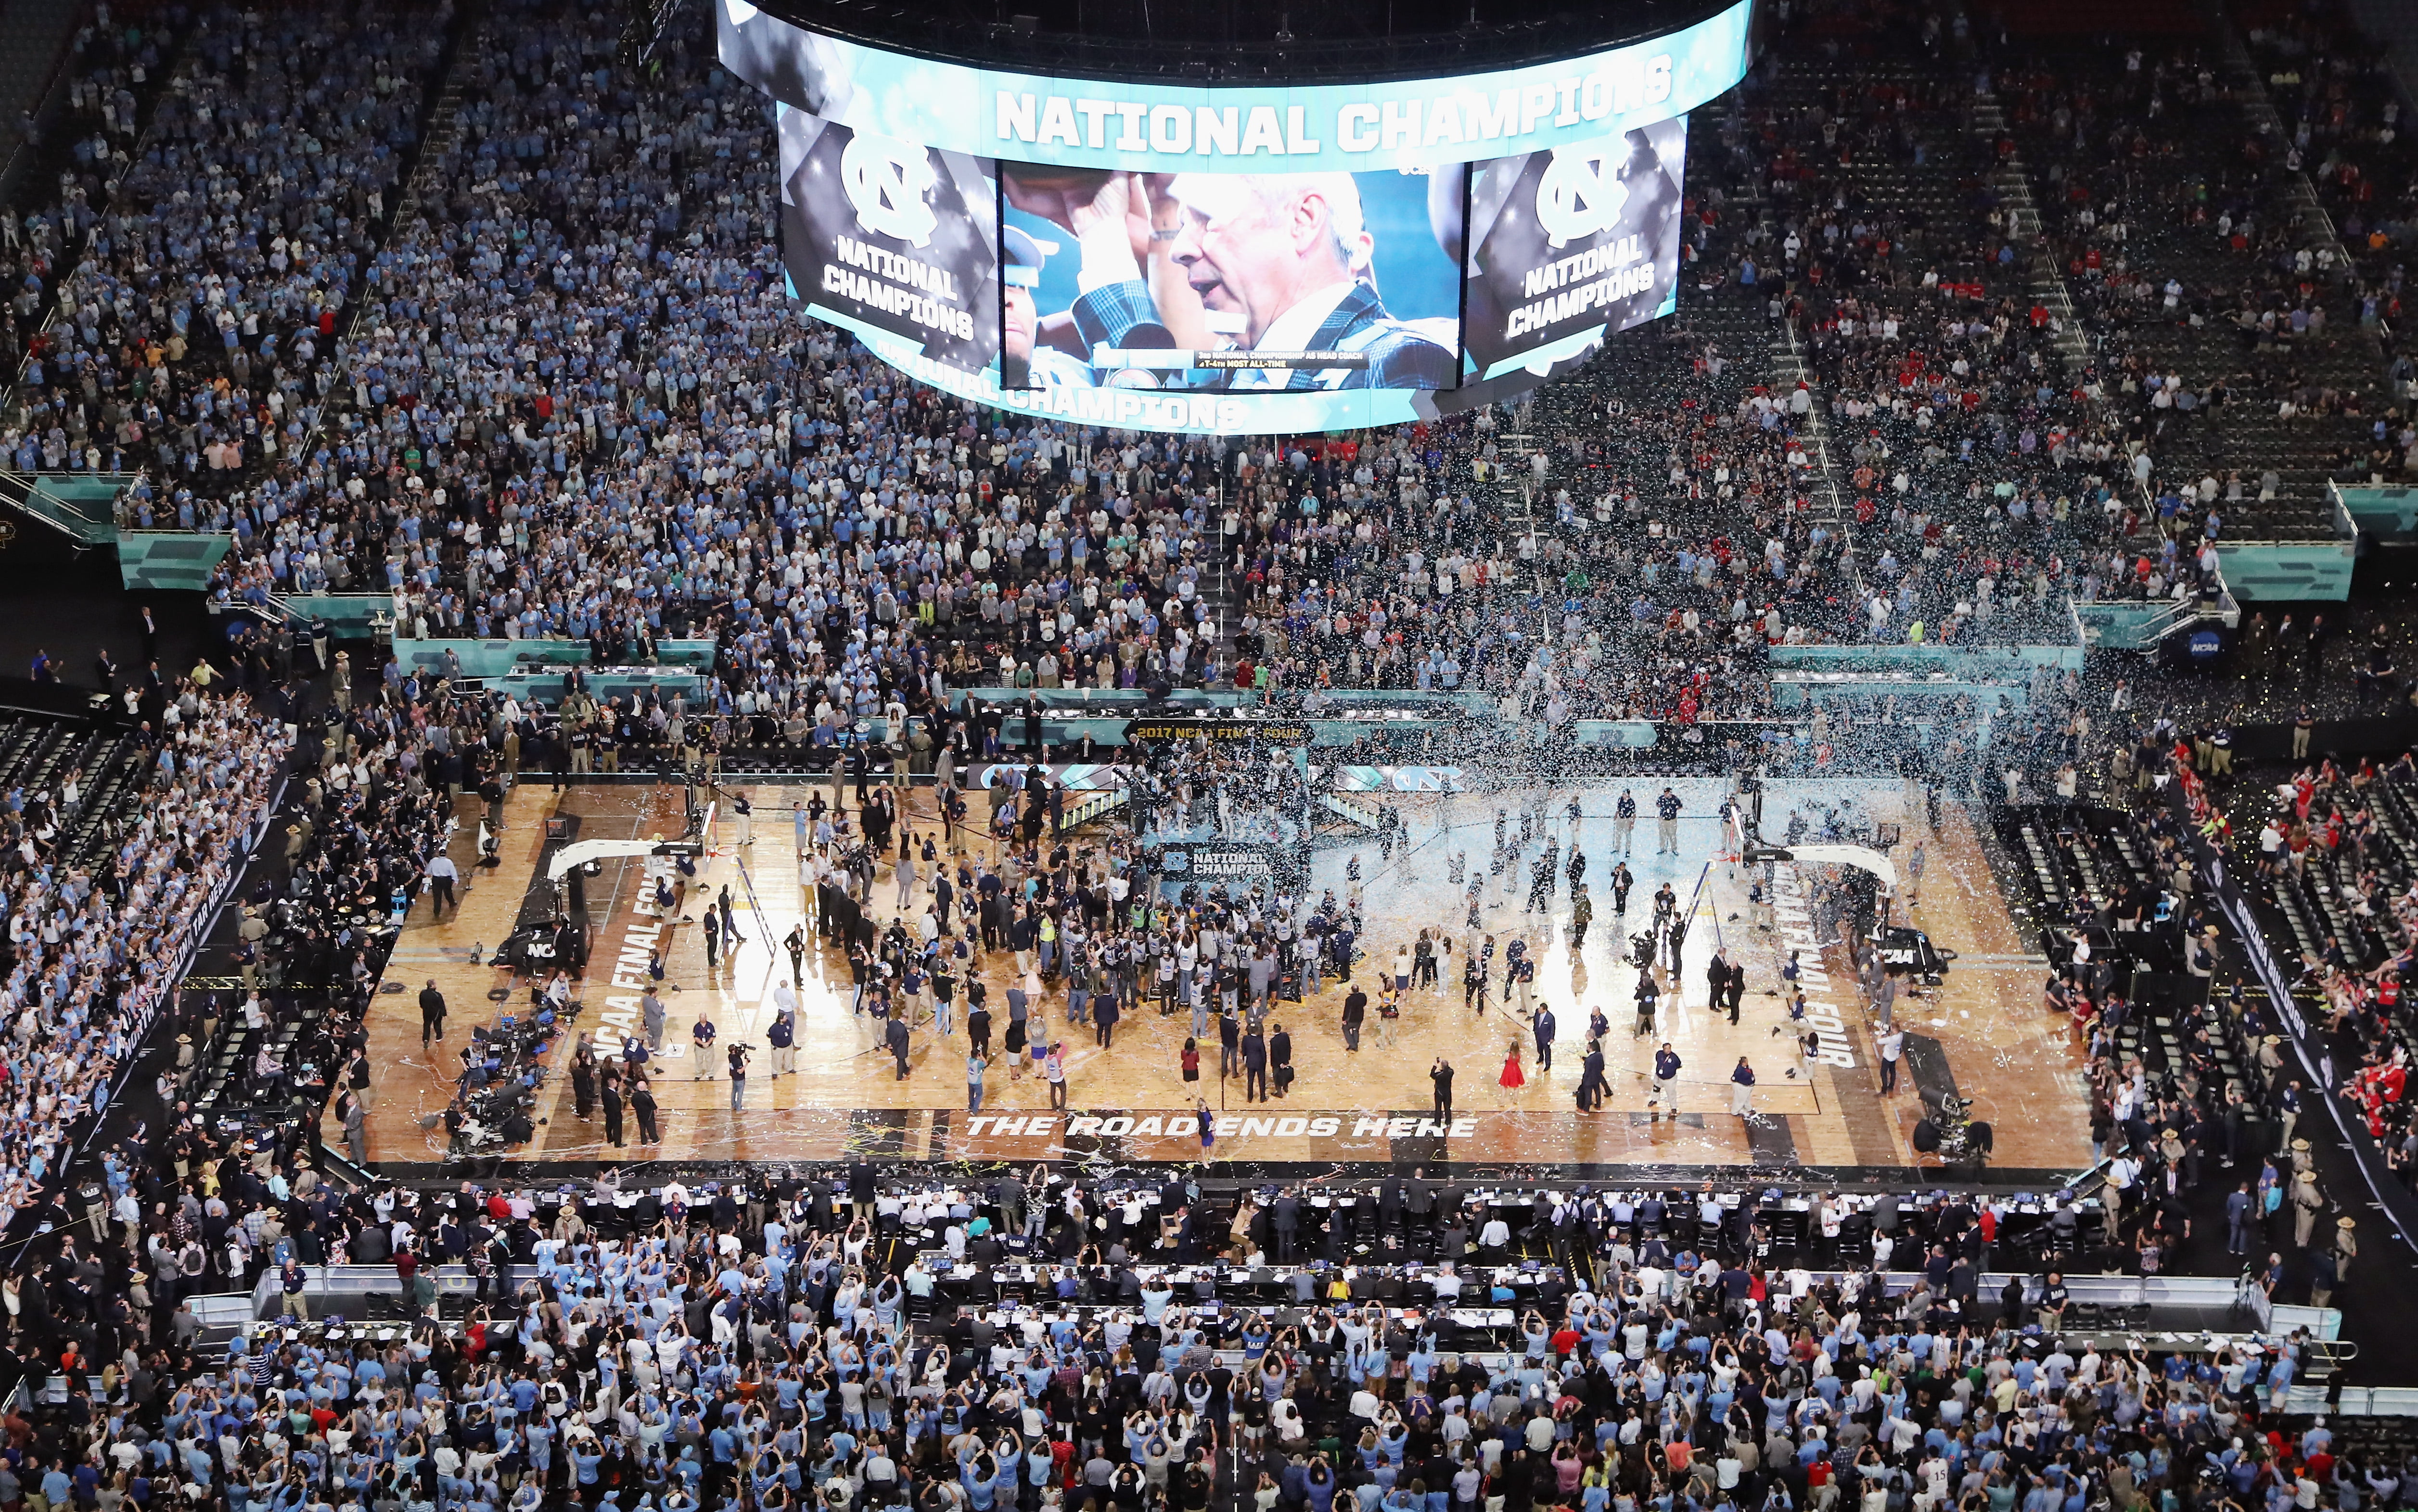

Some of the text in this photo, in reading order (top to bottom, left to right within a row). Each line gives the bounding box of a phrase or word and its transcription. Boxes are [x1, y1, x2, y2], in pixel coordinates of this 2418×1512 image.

[996, 54, 1673, 155] NATIONAL CHAMPIONS
[837, 234, 958, 301] NATIONAL
[1524, 234, 1642, 298] NATIONAL
[823, 264, 974, 342] CHAMPIONS
[1507, 262, 1655, 338] CHAMPIONS
[877, 340, 999, 402] NATIONAL
[1006, 387, 1246, 430] CHAMPIONS
[2192, 643, 2219, 652] NCAA
[1137, 727, 1301, 739] 2017 NCAA FINA FOUR
[1193, 853, 1267, 864] NATIONAL
[1193, 864, 1275, 875] CHAMPION
[154, 933, 194, 1007] CAROLINA
[193, 902, 208, 937] TAR
[610, 922, 663, 990] FINAL
[1780, 927, 1832, 994] FINAL
[2236, 898, 2306, 1040] GONZAGA BULLDOGS
[591, 996, 642, 1063] NCAA
[1804, 1001, 1855, 1069] FOUR
[965, 1116, 1479, 1138] THE ROAD ENDS HERE
[1756, 1247, 1768, 1257] 25
[1935, 1470, 1945, 1481] 15
